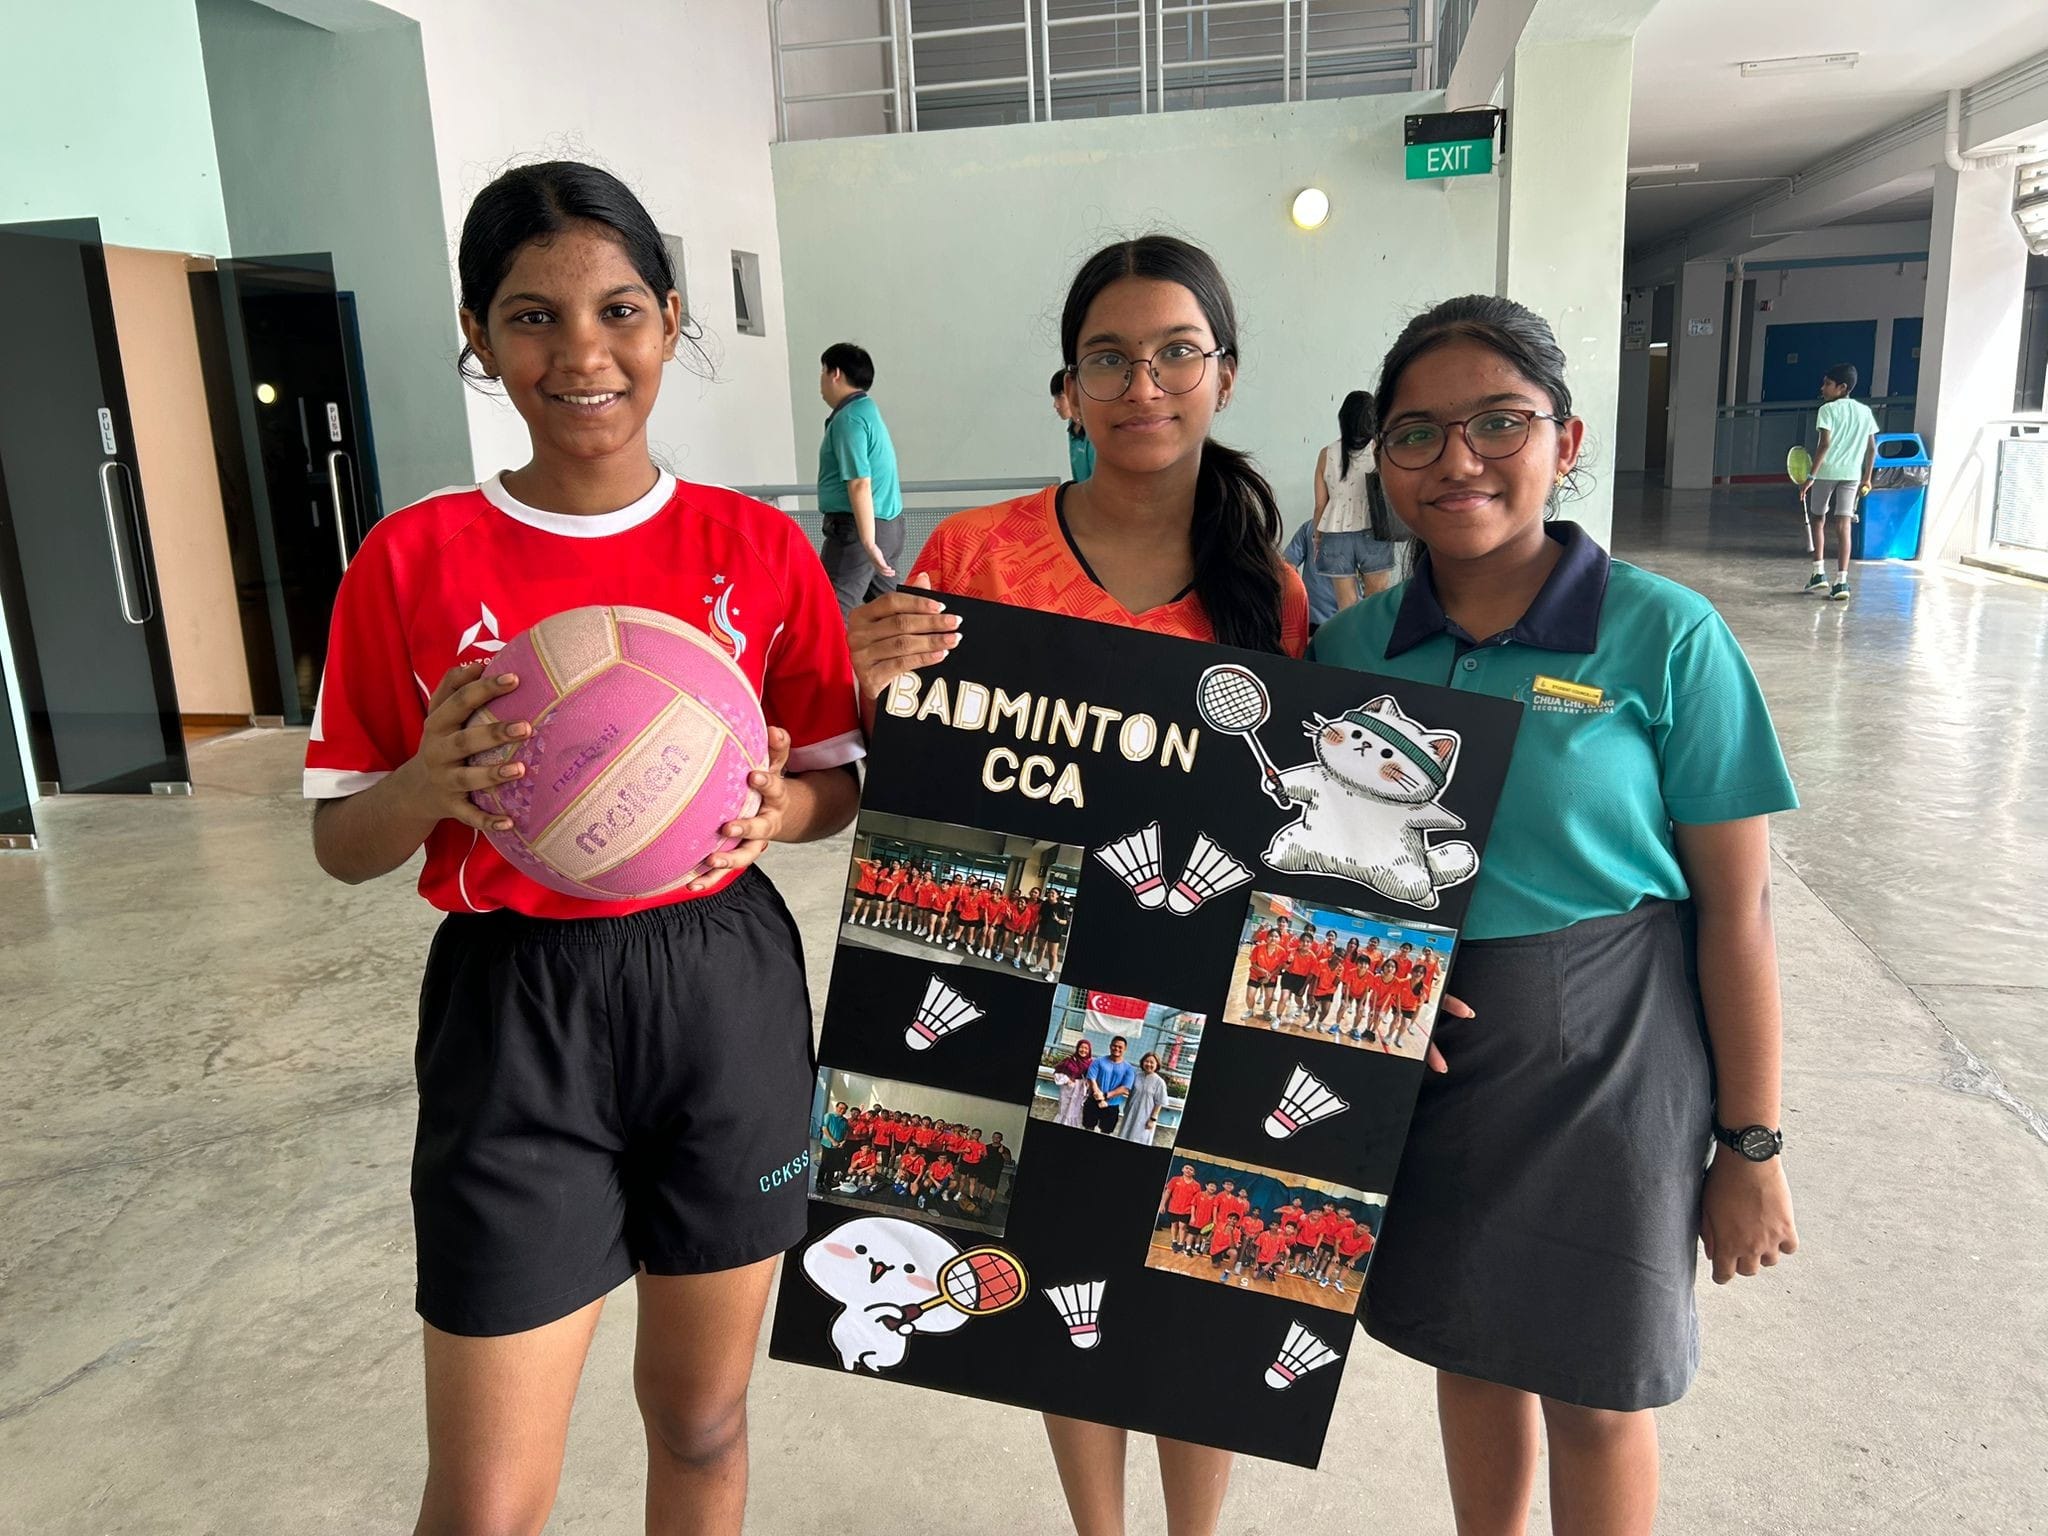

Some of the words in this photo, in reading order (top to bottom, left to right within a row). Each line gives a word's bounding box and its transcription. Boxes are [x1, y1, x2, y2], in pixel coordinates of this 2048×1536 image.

[1428, 145, 1472, 172] EXIT
[101, 412, 114, 450] PULL
[330, 407, 340, 438] PUSH
[886, 671, 1200, 772] BADMINTON
[1532, 705, 1580, 714] SECONDARY
[1533, 695, 1561, 707] CHUA
[553, 723, 619, 793] netball
[982, 747, 1084, 808] CCA
[575, 745, 690, 856] molten
[759, 1149, 809, 1193] CCKSS
